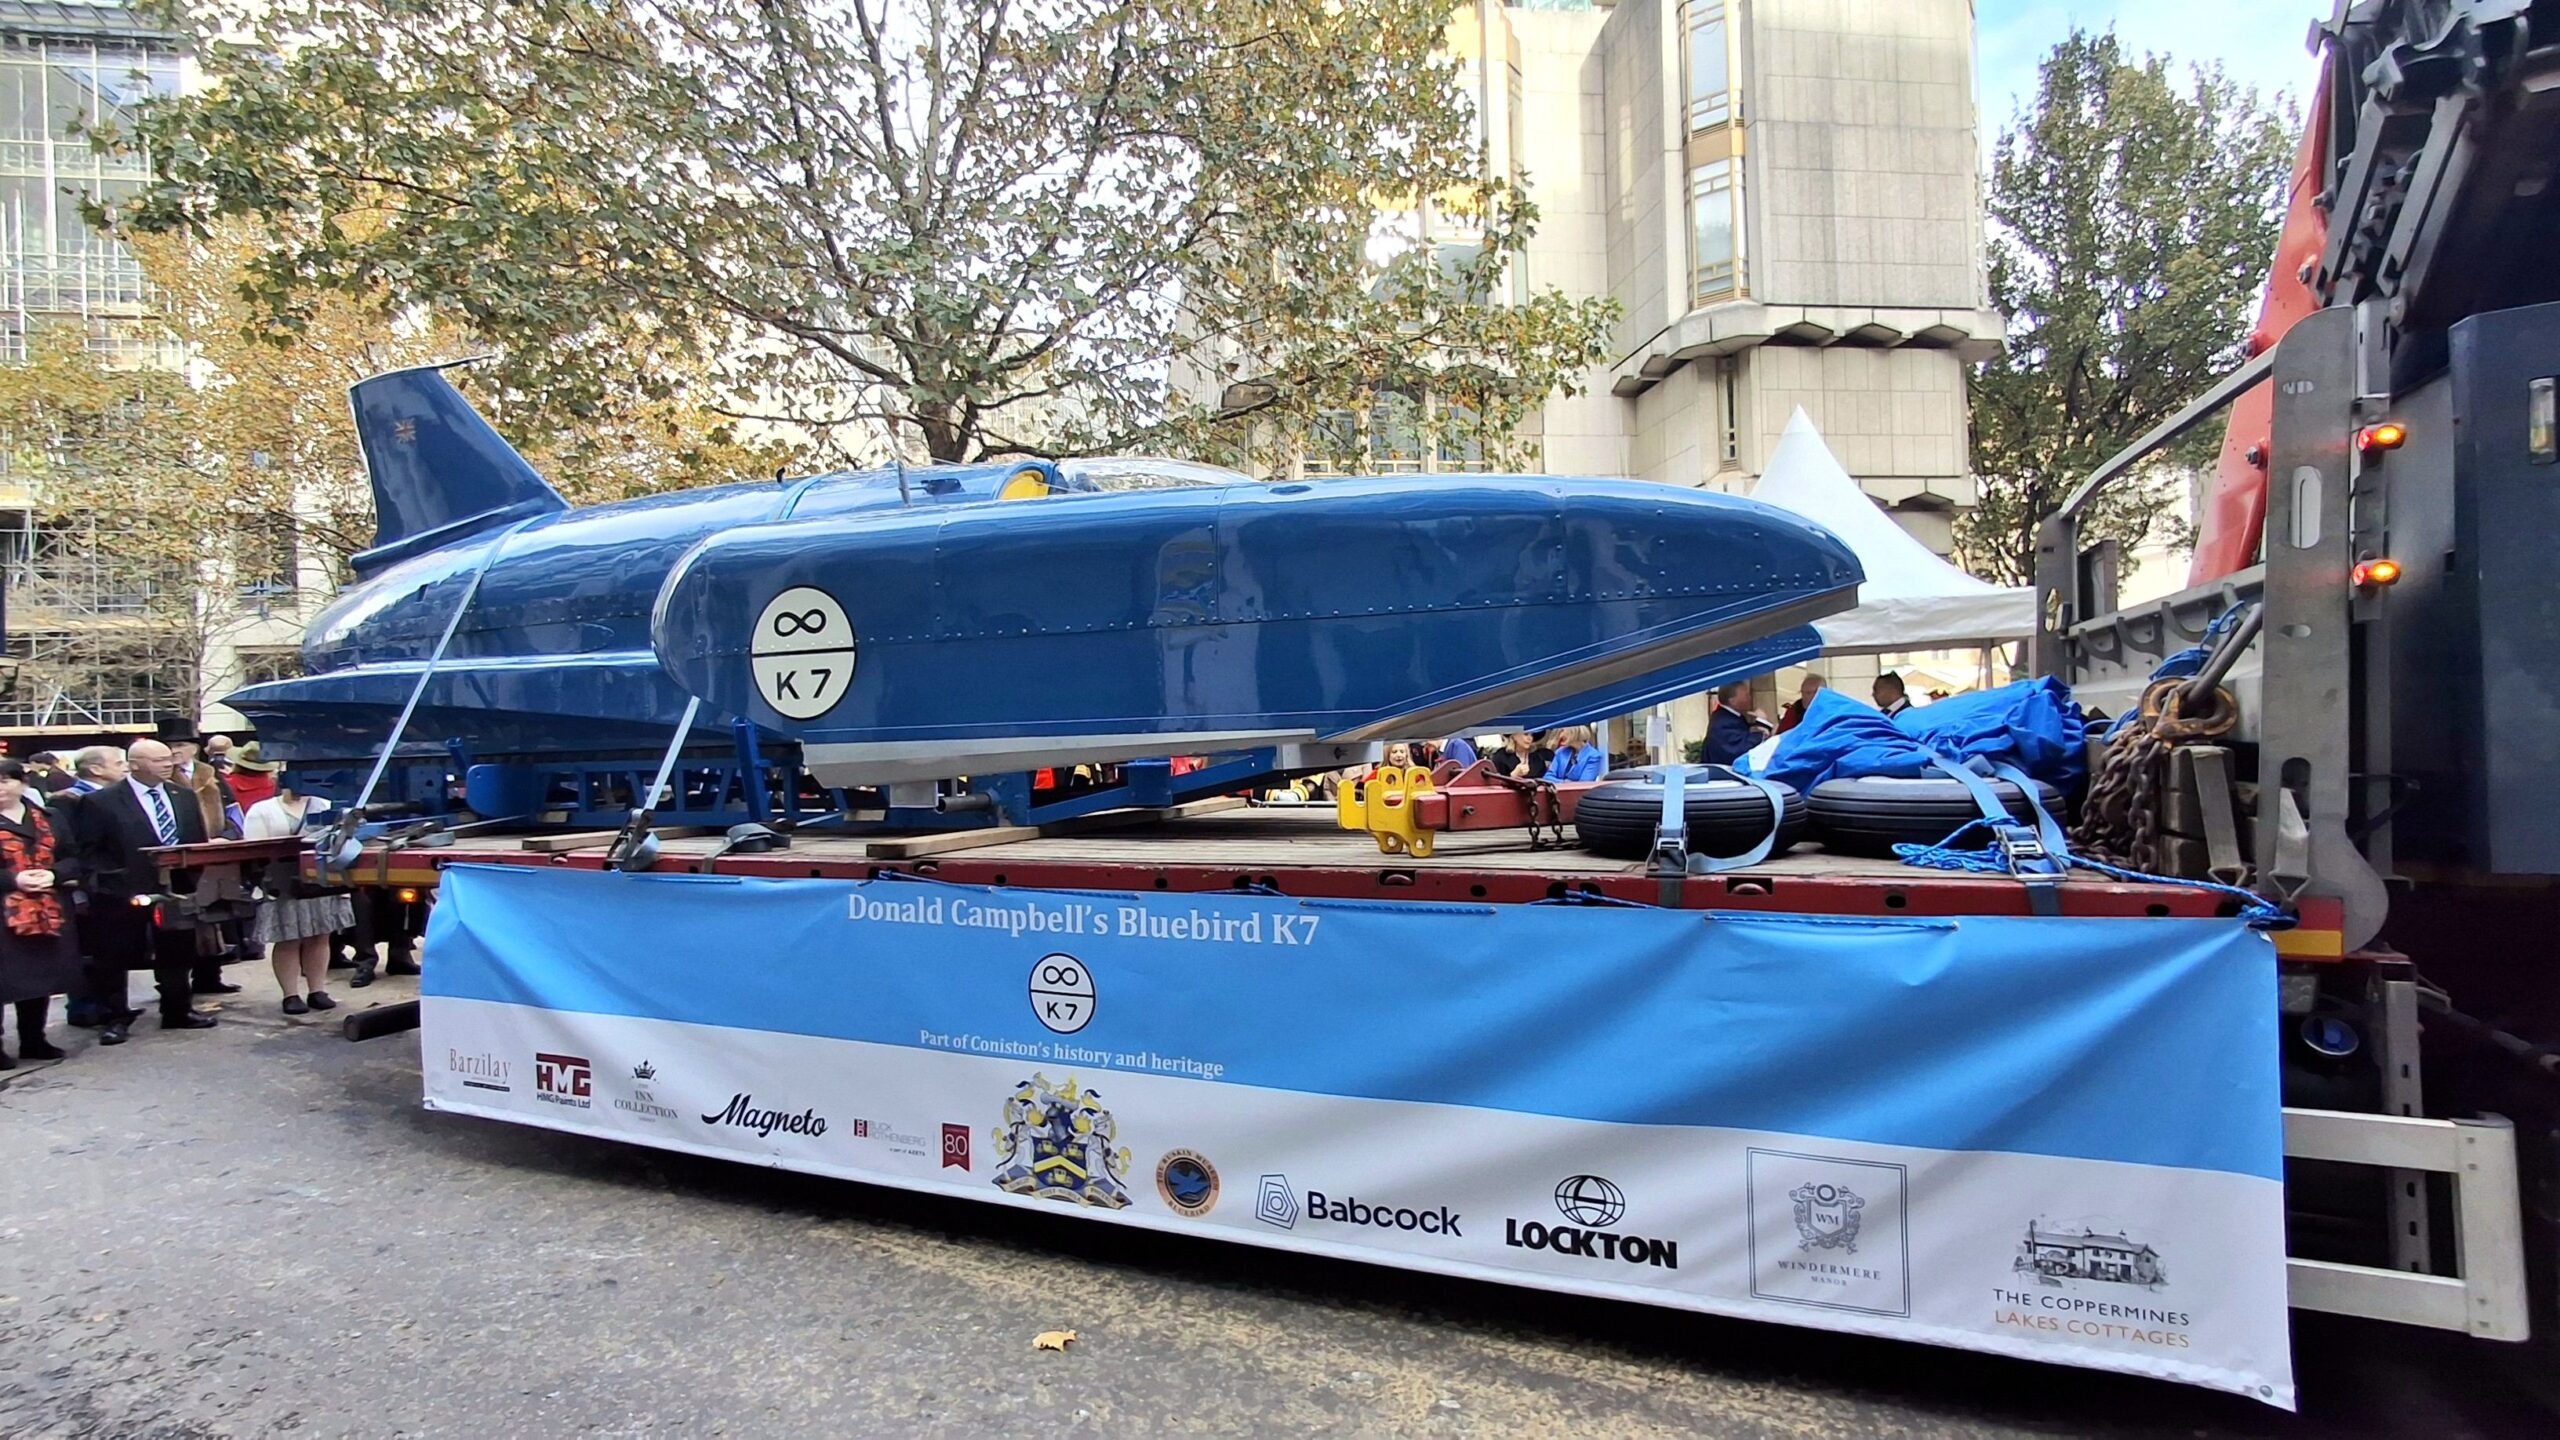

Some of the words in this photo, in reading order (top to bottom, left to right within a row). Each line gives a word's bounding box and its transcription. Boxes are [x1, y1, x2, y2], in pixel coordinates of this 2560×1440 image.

[847, 893, 944, 925] Donald
[951, 899, 1109, 938] Campbell's
[1117, 907, 1262, 944] Bluebird
[1272, 913, 1320, 946] K7
[449, 1047, 512, 1085] Barzilay
[920, 1029, 950, 1048] Part
[952, 1034, 969, 1049] of
[970, 1035, 1050, 1058] Coniston's
[1054, 1043, 1112, 1068] history
[1115, 1052, 1147, 1069] and
[1151, 1053, 1224, 1081] heritage
[536, 1052, 591, 1098] HMG
[536, 1091, 554, 1104] HMG
[578, 1098, 591, 1109] Ltd
[614, 1098, 678, 1119] COLLECTION
[634, 1090, 654, 1102] INN
[701, 1092, 829, 1138] Magneto
[944, 1133, 968, 1156] 80
[1306, 1190, 1463, 1238] Babcock
[1815, 1212, 1840, 1226] WM
[1505, 1217, 1679, 1270] LOCKTON
[1777, 1260, 1881, 1281] WINDERMERE
[1810, 1275, 1847, 1286] MANOR
[1992, 1288, 2032, 1306] THE
[2041, 1295, 2190, 1327] COPPERMINES
[1995, 1310, 2059, 1331] LAKES
[2067, 1319, 2190, 1349] COTTAGES
